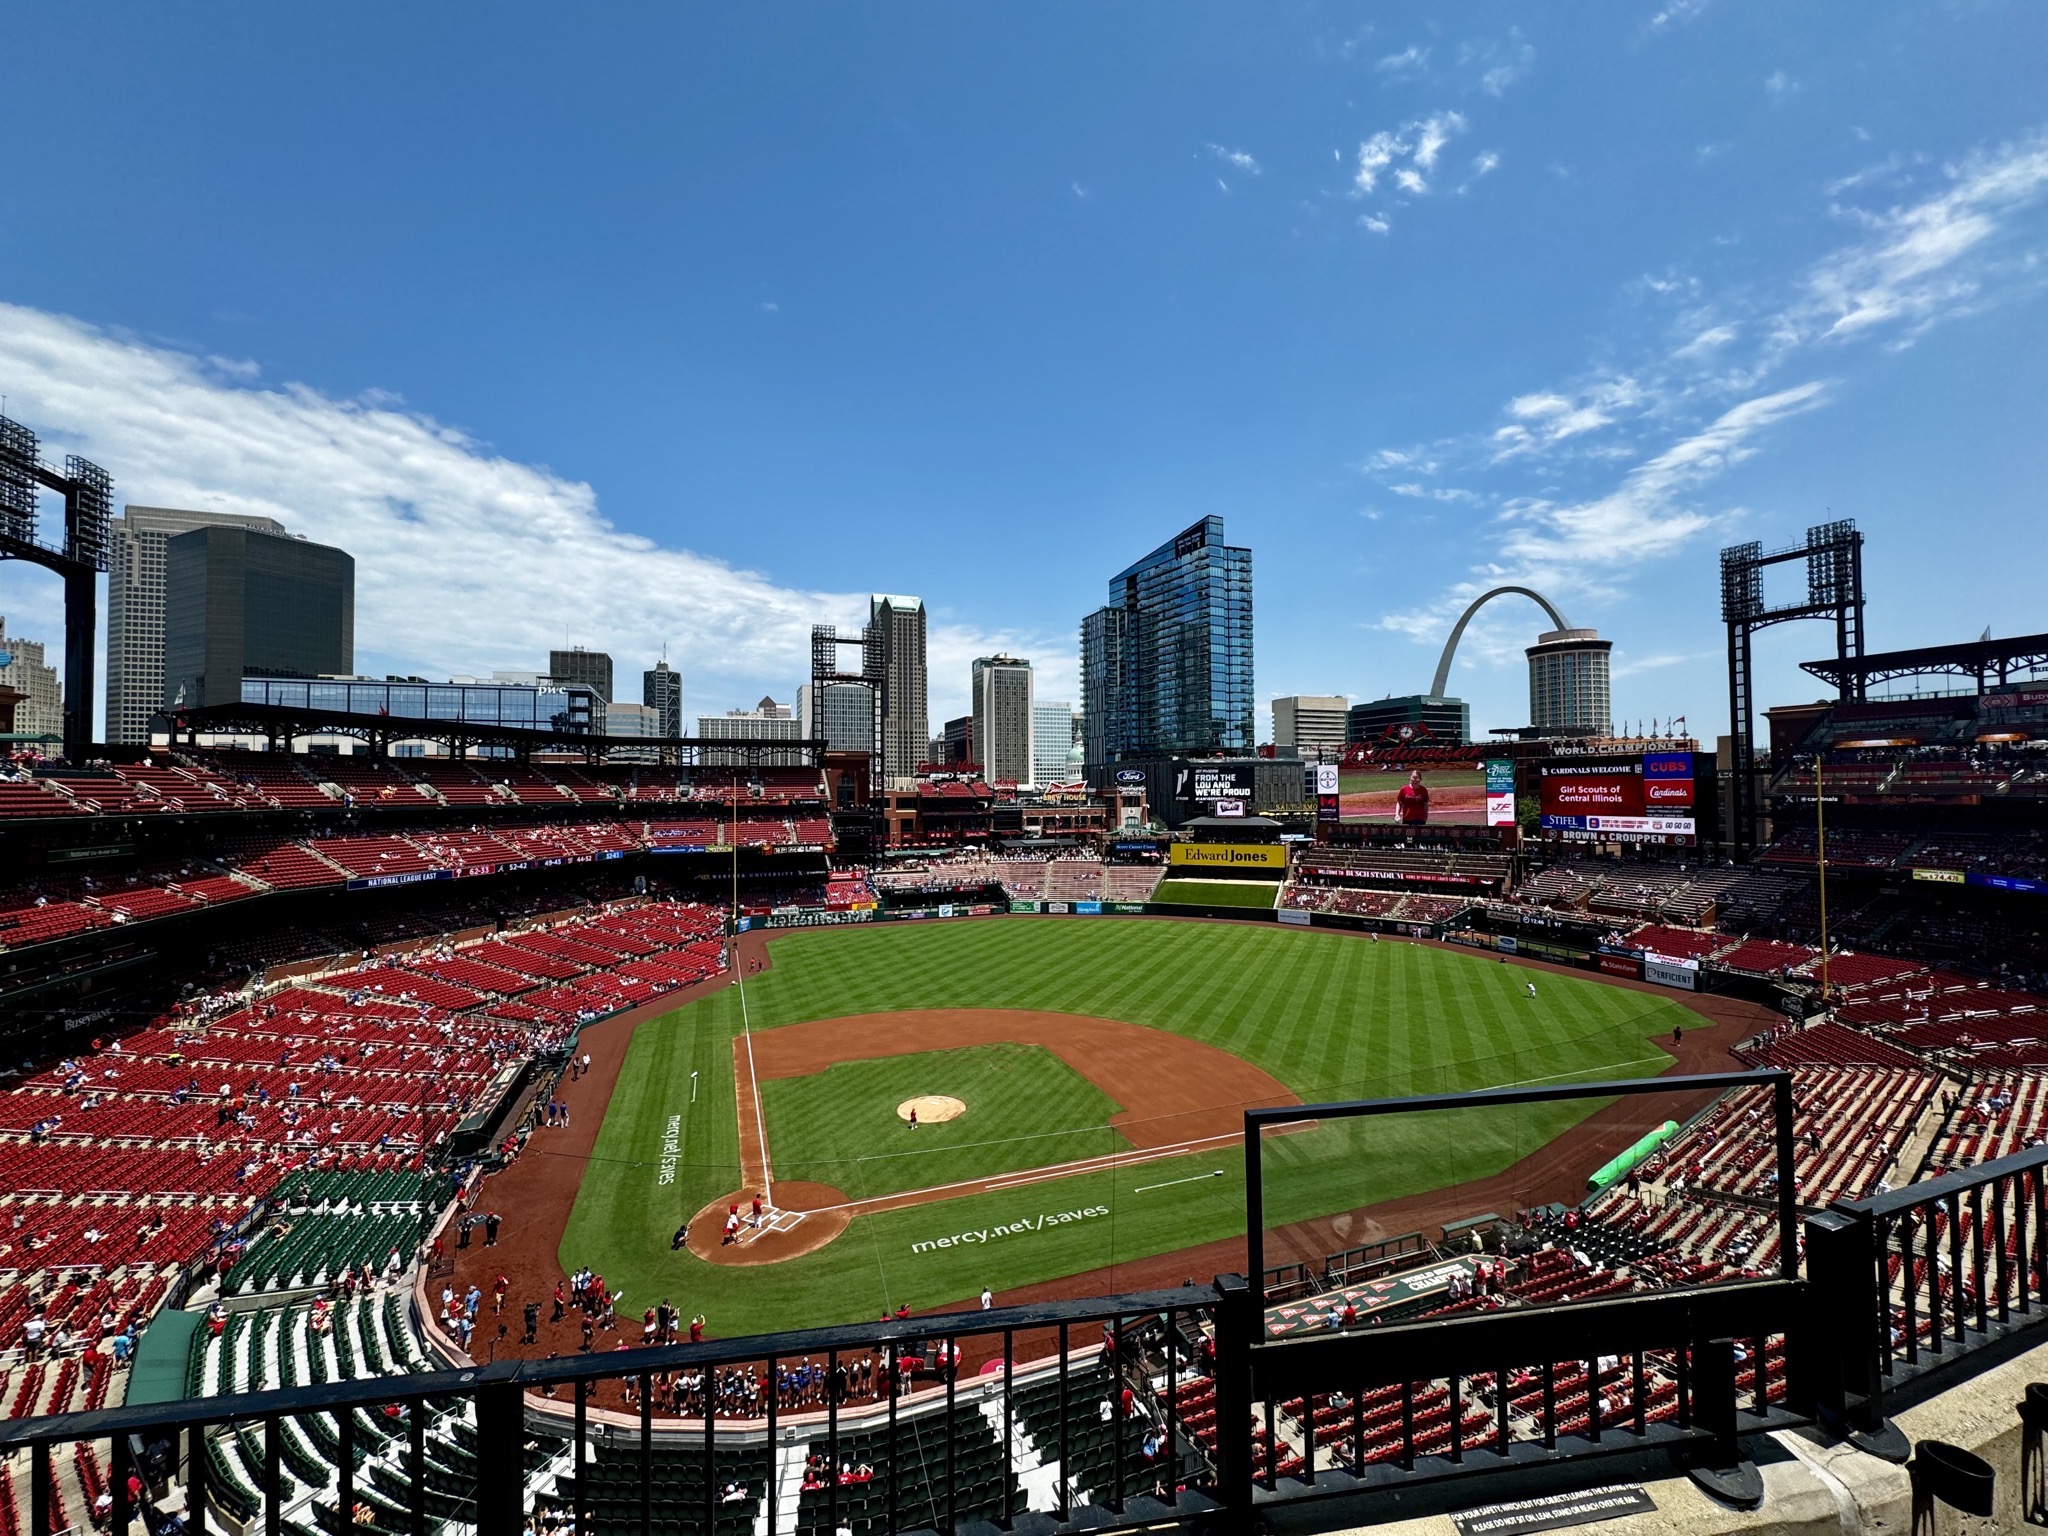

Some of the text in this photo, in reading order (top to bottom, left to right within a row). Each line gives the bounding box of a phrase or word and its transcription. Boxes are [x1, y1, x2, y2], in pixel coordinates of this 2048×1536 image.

[538, 685, 567, 696] pwc
[1554, 741, 1676, 756] WORLD CHAMPIONS
[1650, 762, 1686, 772] CUBS
[1195, 781, 1230, 789] LOU AND
[1195, 788, 1250, 796] WE'RE PROUD
[1650, 786, 1687, 798] Cardinals
[1492, 803, 1511, 811] JF
[1549, 815, 1578, 825] STIFEL
[1563, 831, 1597, 840] BROWN
[1609, 833, 1666, 843] CROUPPEN
[1185, 849, 1267, 862] Edward Jones
[469, 867, 489, 875] 62-33
[1370, 871, 1404, 879] STADIUM
[368, 877, 399, 886] NATIONAL
[400, 875, 421, 884] LEAGUE
[1608, 962, 1622, 970] State
[658, 1115, 682, 1185] mercy.net/saves
[912, 1204, 1109, 1253] mercy.net/saves
[1400, 1263, 1463, 1284] WORLD SERIES
[1409, 1268, 1472, 1291] CHAMPIONS
[1451, 1513, 1464, 1521] FOR
[1463, 1509, 1481, 1519] YOUR
[1480, 1505, 1503, 1516] SAFETY,
[1501, 1502, 1521, 1511] WATCH
[1521, 1500, 1534, 1509] OUT
[1533, 1498, 1545, 1507] FOR
[1545, 1494, 1570, 1504] OBJECTS
[1568, 1489, 1593, 1500] LEAVING
[1591, 1487, 1604, 1496] THE
[1602, 1484, 1626, 1494] PLAYING
[1472, 1495, 1640, 1532] PLEASE DO NOT SIT ON, LEAN, STAND OR REACH OVER THE RAIL.
